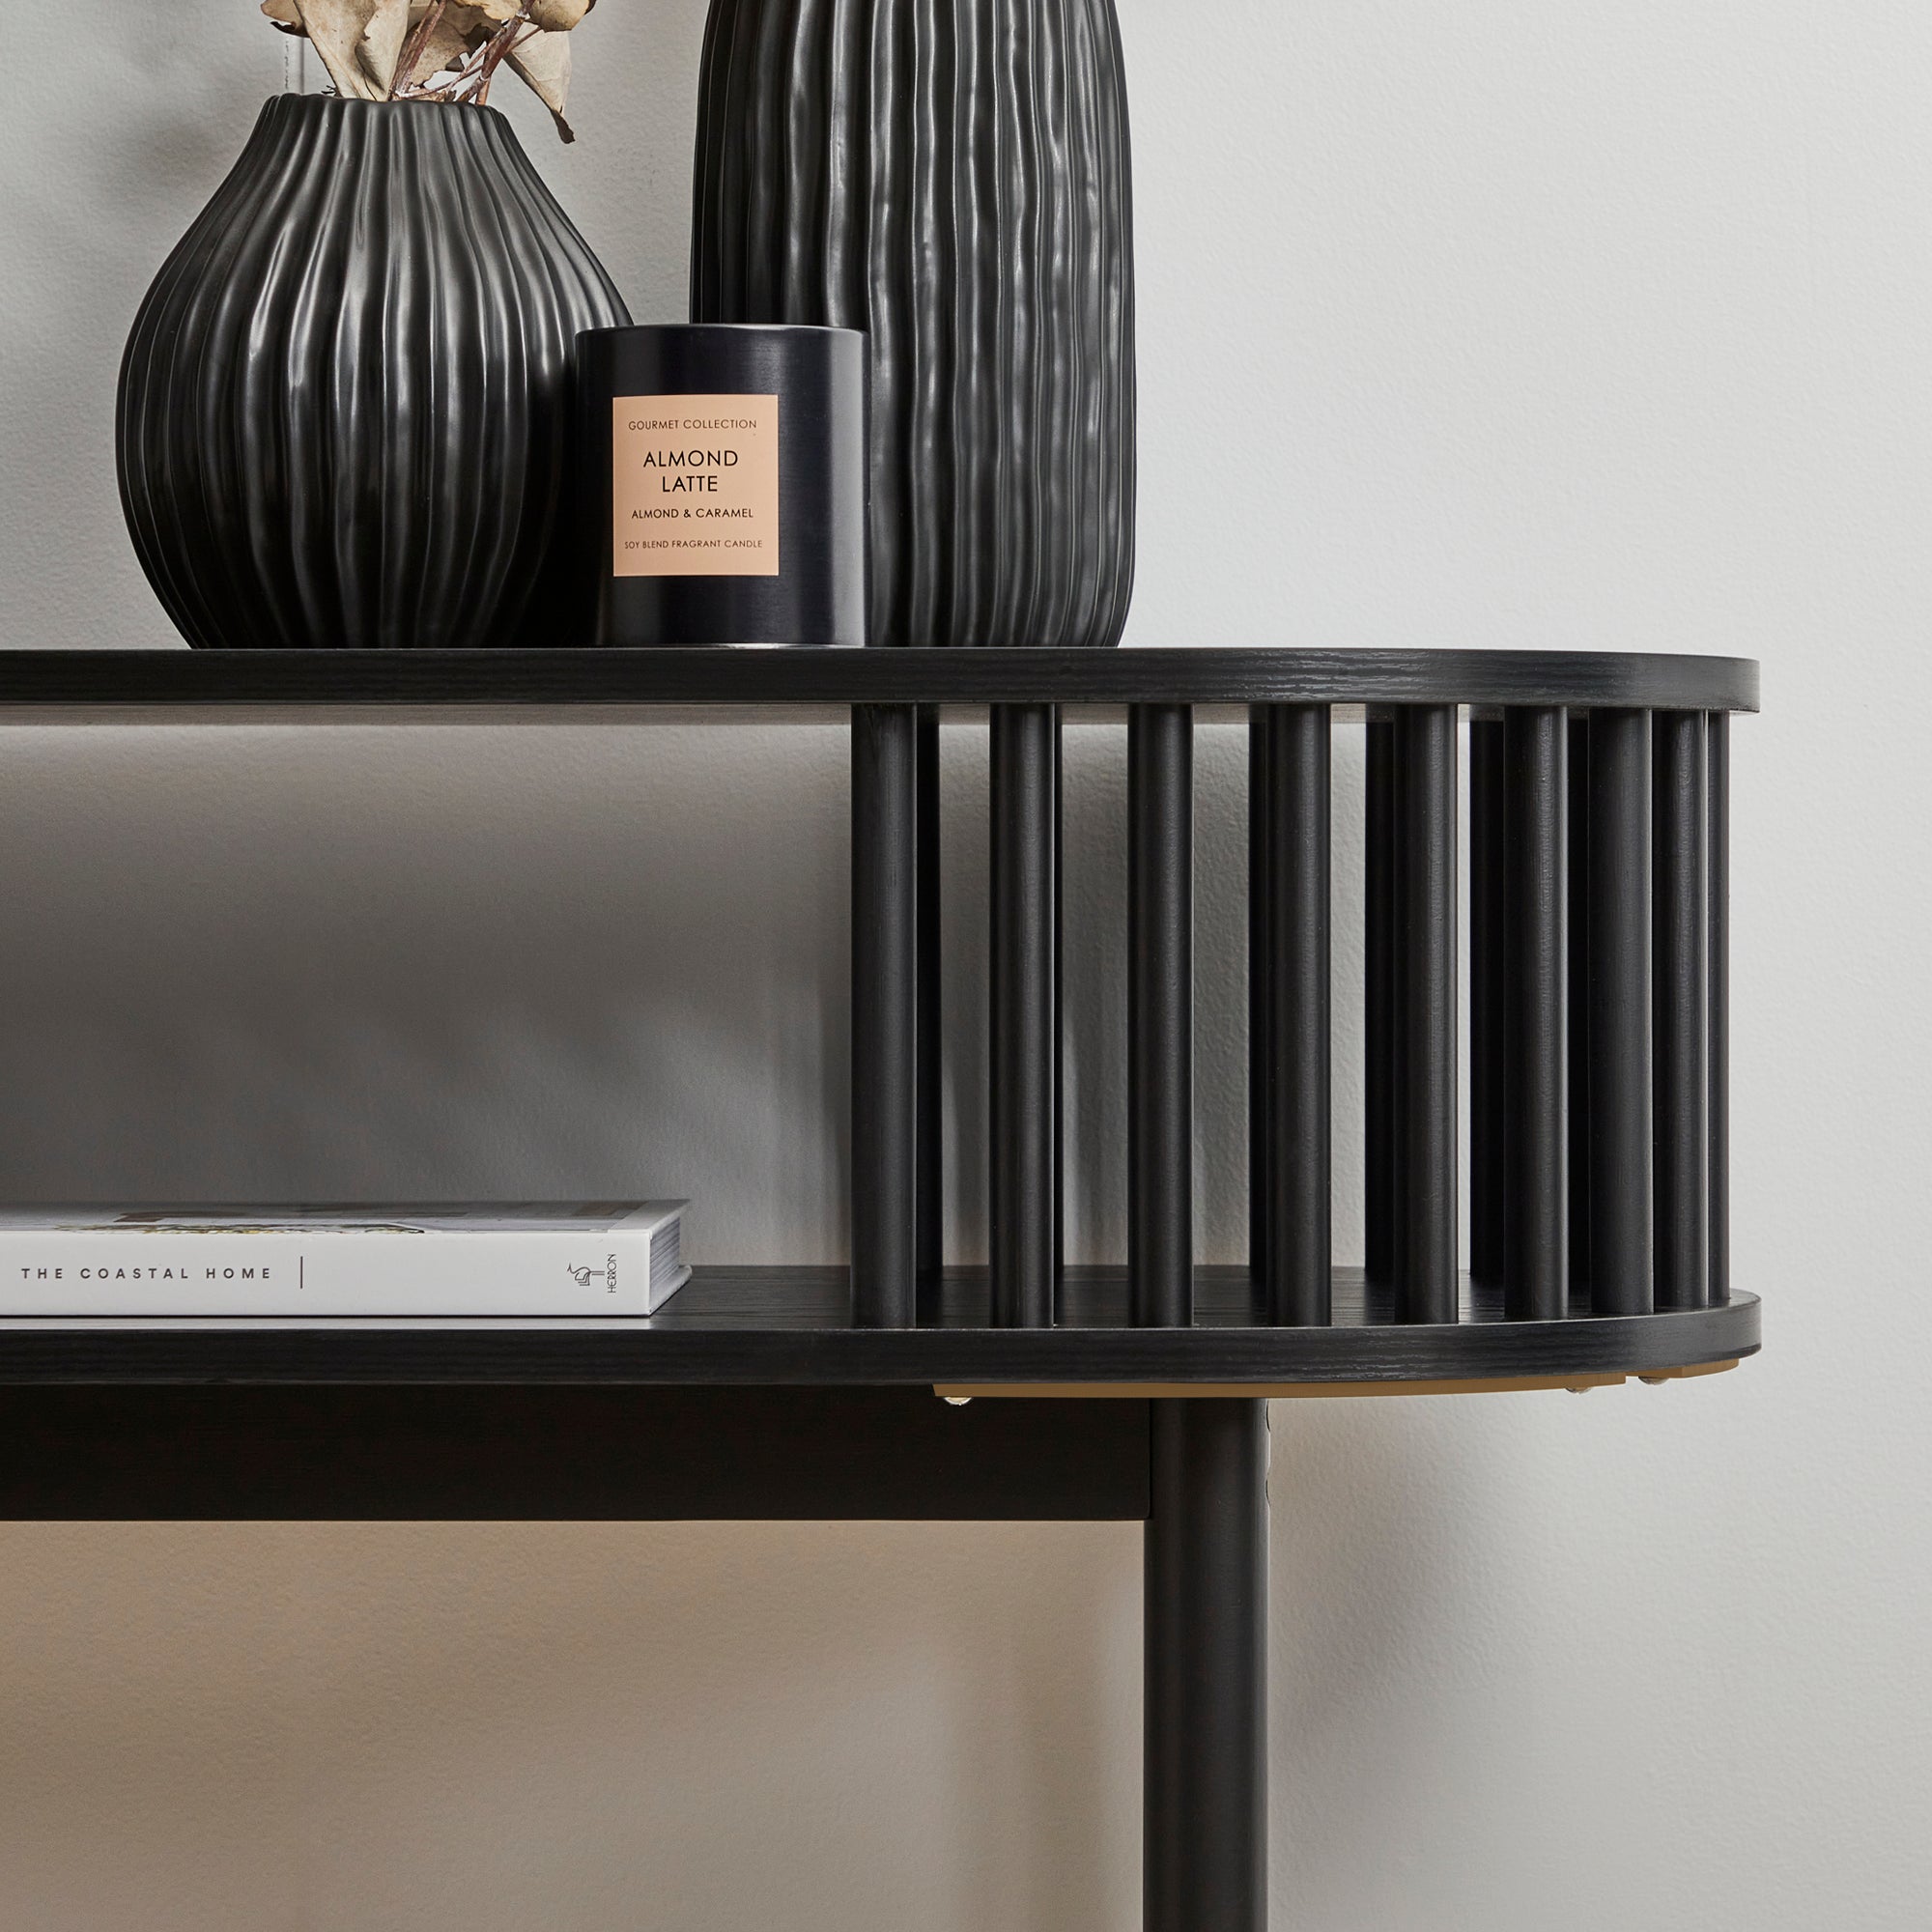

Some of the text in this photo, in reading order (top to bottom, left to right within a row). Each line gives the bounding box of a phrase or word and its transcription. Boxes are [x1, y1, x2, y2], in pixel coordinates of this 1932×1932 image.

[628, 418, 757, 431] GOURMET COLLECTION
[642, 449, 739, 468] ALMOND
[662, 475, 718, 493] LATTE
[631, 508, 753, 519] ALMOND & CARAMEL
[624, 539, 762, 550] SOY BLEND FRAGRANT CANDLE
[20, 1267, 270, 1280] THE COASTAL HOME
[607, 1253, 617, 1293] HERRON
